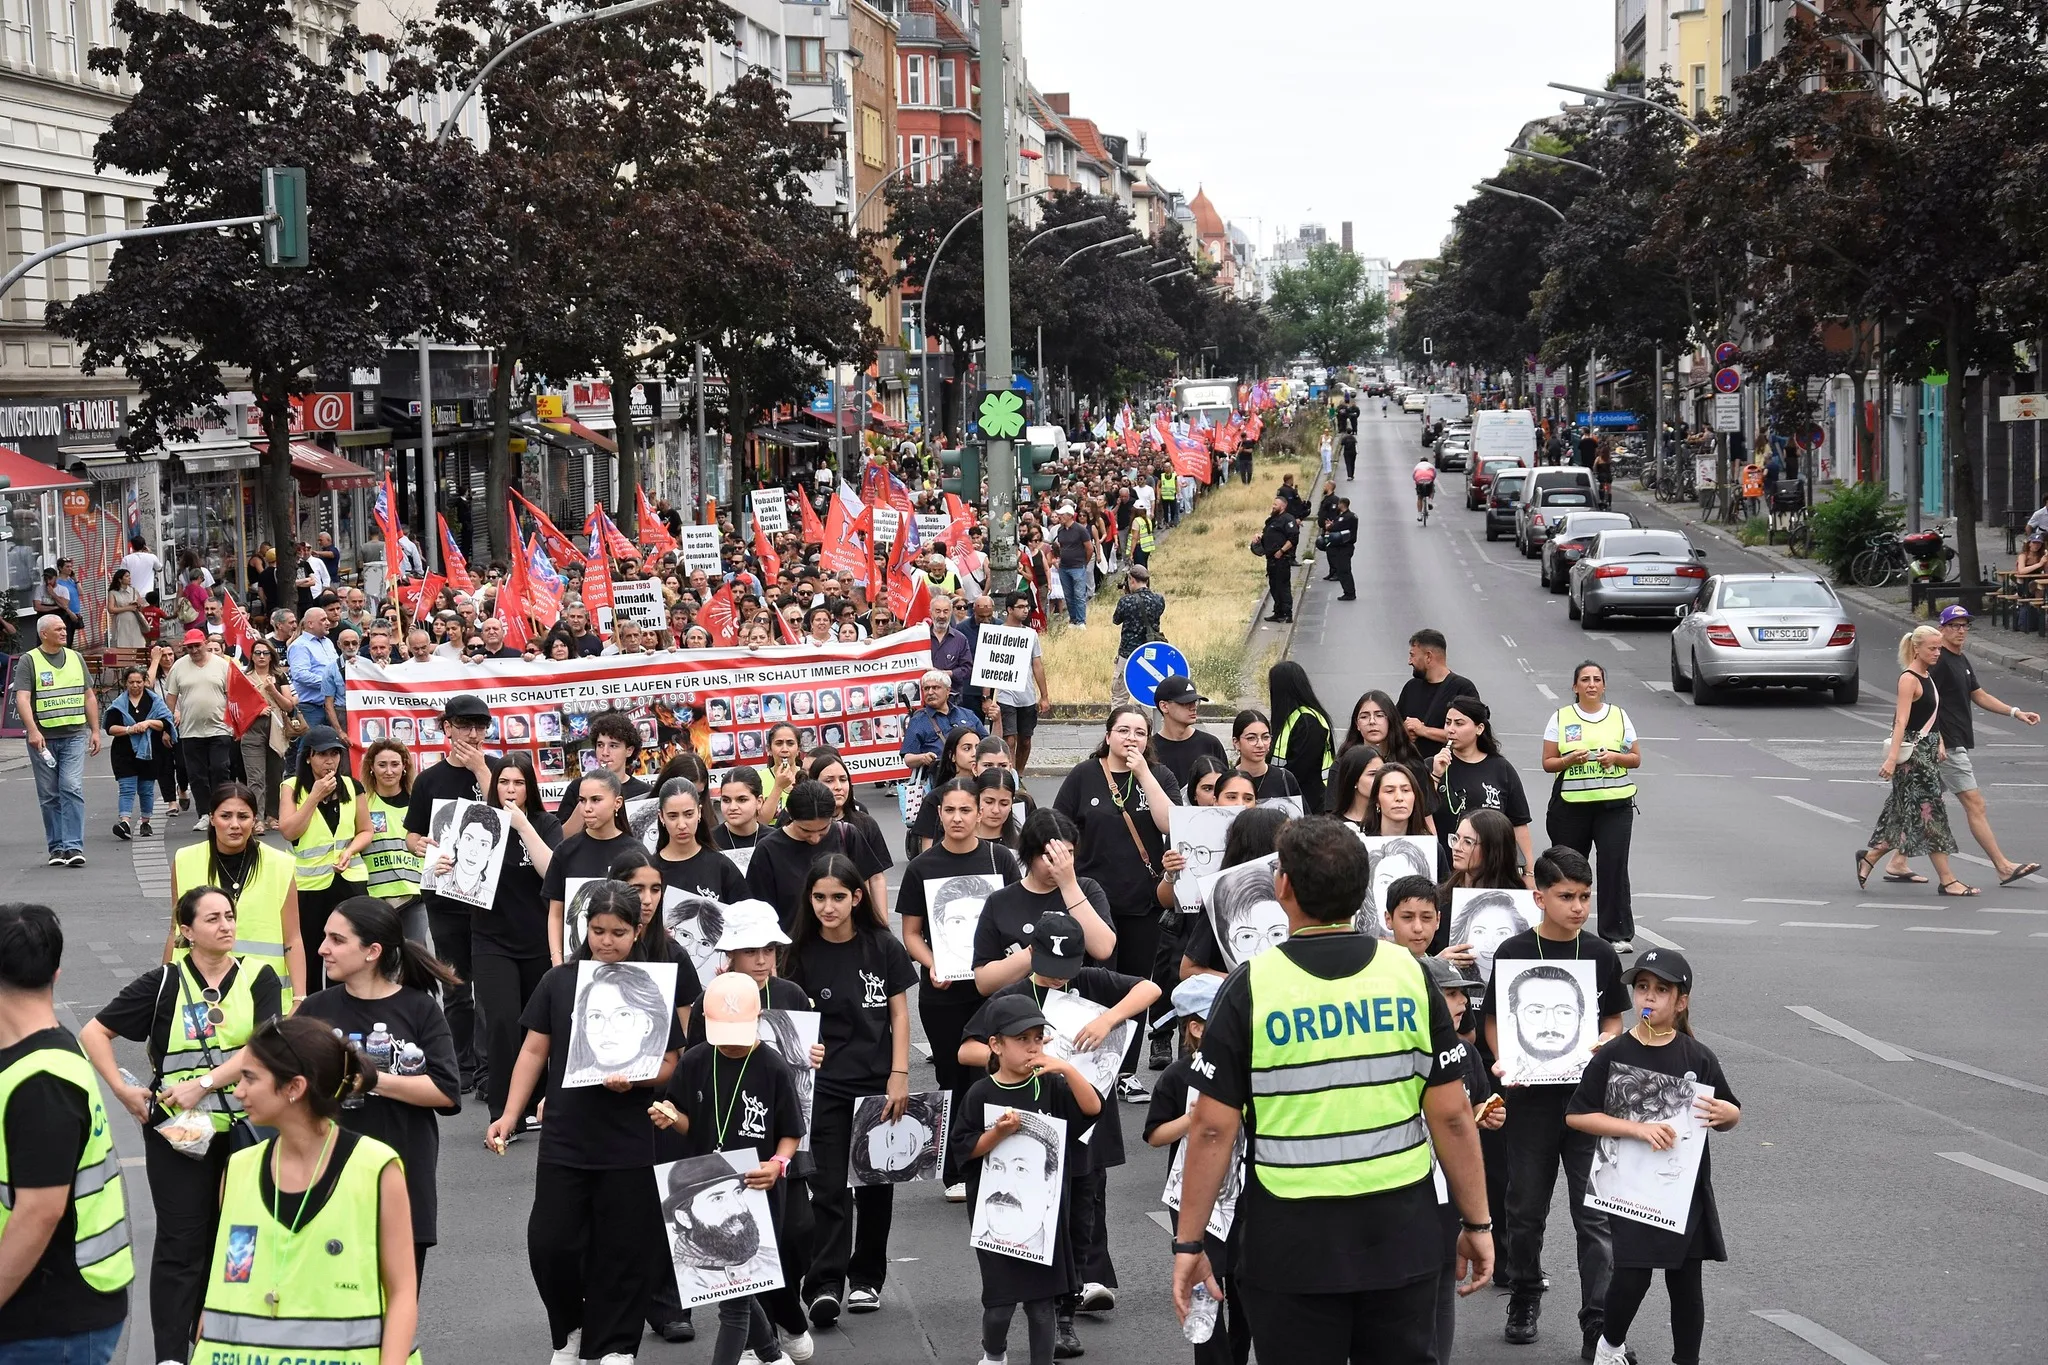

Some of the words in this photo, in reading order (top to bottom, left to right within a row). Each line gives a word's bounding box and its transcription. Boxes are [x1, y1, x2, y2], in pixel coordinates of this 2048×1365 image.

[84, 400, 119, 429] MOBILE
[314, 394, 343, 430] @
[472, 399, 490, 419] HOTEL
[24, 406, 60, 436] STUDIO
[64, 491, 86, 505] ria
[754, 496, 782, 504] Yobazlar
[760, 514, 781, 522] Devlet
[835, 547, 856, 557] Berlin
[636, 582, 651, 590] 1993
[614, 592, 657, 604] utmadık,
[982, 631, 1002, 646] Katil
[1002, 634, 1029, 649] devlet
[1765, 630, 1775, 638] RN
[1780, 629, 1790, 638] SC
[1792, 629, 1808, 638] 100
[989, 650, 1015, 666] hesap
[362, 695, 386, 705] WIR
[388, 695, 453, 706] VERBRANN
[486, 693, 507, 703] IHR
[511, 687, 576, 702] SCHAUTET
[579, 686, 598, 697] ZU,
[602, 683, 620, 694] SIE
[624, 679, 672, 692] LAUFEN
[676, 676, 699, 688] FÜR
[703, 674, 731, 686] UNS,
[735, 672, 754, 683] IHR
[758, 668, 808, 682] SCHAUT
[811, 665, 851, 677] IMMER
[853, 662, 888, 673] NOCH
[891, 657, 919, 669] ZU!!!
[981, 668, 1013, 683] verecek
[563, 699, 609, 713] SİVAS
[614, 692, 696, 709] 02-07-1993
[847, 755, 904, 771] RSUNUZ!!!
[441, 889, 487, 907] ONURUMUZDUR
[944, 972, 973, 980] ONURU
[1265, 996, 1418, 1047] ORDNER
[937, 1098, 950, 1172] ONURUMUZDUR
[1593, 1198, 1677, 1228] ONURUMUZDUR
[1609, 1195, 1634, 1208] CARINA
[1634, 1202, 1662, 1215] CUANNA
[977, 1239, 1045, 1262] ONURUMUZDUR
[690, 1278, 774, 1304] ONURUMUZDUR
[710, 1281, 728, 1291] ASAF
